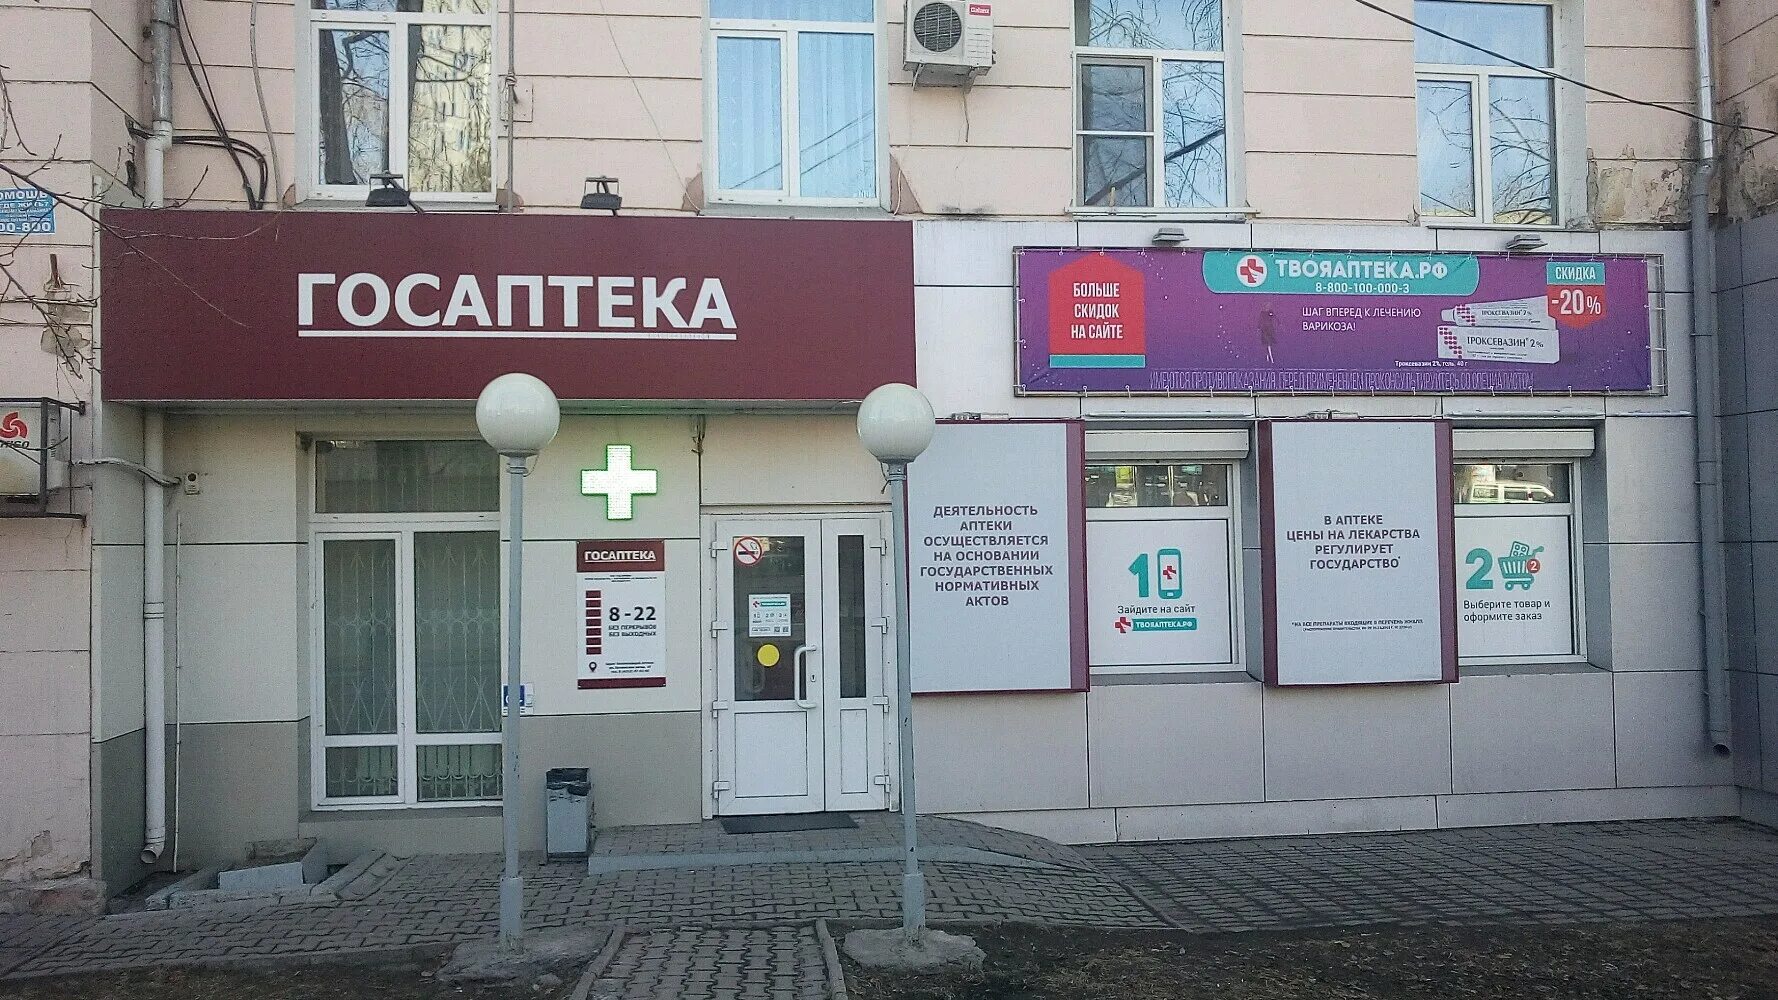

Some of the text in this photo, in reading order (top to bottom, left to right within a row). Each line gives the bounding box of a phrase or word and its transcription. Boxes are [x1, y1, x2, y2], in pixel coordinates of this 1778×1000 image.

[1275, 259, 1448, 279] ТВОЯАПТЕКА.РФ
[1555, 266, 1596, 281] СКИДКА
[1073, 282, 1120, 298] БОЛЬШЕ
[1315, 282, 1410, 294] 8-800-100-000-3
[298, 272, 737, 329] ГОСАПТЕКА
[1074, 303, 1119, 319] СКИДОК
[1302, 307, 1421, 318] ШАГ ВПЕРЕД К ЛЕЧЕНИЮ
[1071, 322, 1123, 339] НА САЙТЕ
[1302, 321, 1356, 331] ВАРИКОЗА!
[933, 505, 1038, 518] ДЕЯТЕЛЬНОСТЬ
[960, 520, 1012, 531] АПТЕКИ
[1324, 514, 1384, 525] В АПТЕКЕ
[923, 535, 1049, 548] ОСУЩЕСТВЛЯЕТСЯ
[1286, 529, 1421, 542] ЦЕНЫ НА ЛЕКАРСТВА
[1315, 543, 1394, 554] РЕГУЛИРУЕТ
[584, 550, 656, 560] ГОСАПТЕКА
[933, 550, 1040, 562] НА ОСНОВАНИИ
[920, 565, 1054, 578] ГОСУДАРСТВЕННЫХ
[1465, 548, 1494, 590] 2
[1530, 560, 1538, 571] 2
[935, 580, 1040, 592] НОРМАТИВНЫХ
[965, 596, 1009, 607] АКТОВ
[1463, 600, 1551, 610] Выберите товар и
[1117, 604, 1158, 615] Зайдите
[1173, 604, 1196, 613] сайт
[1463, 612, 1543, 623] оформите заказ
